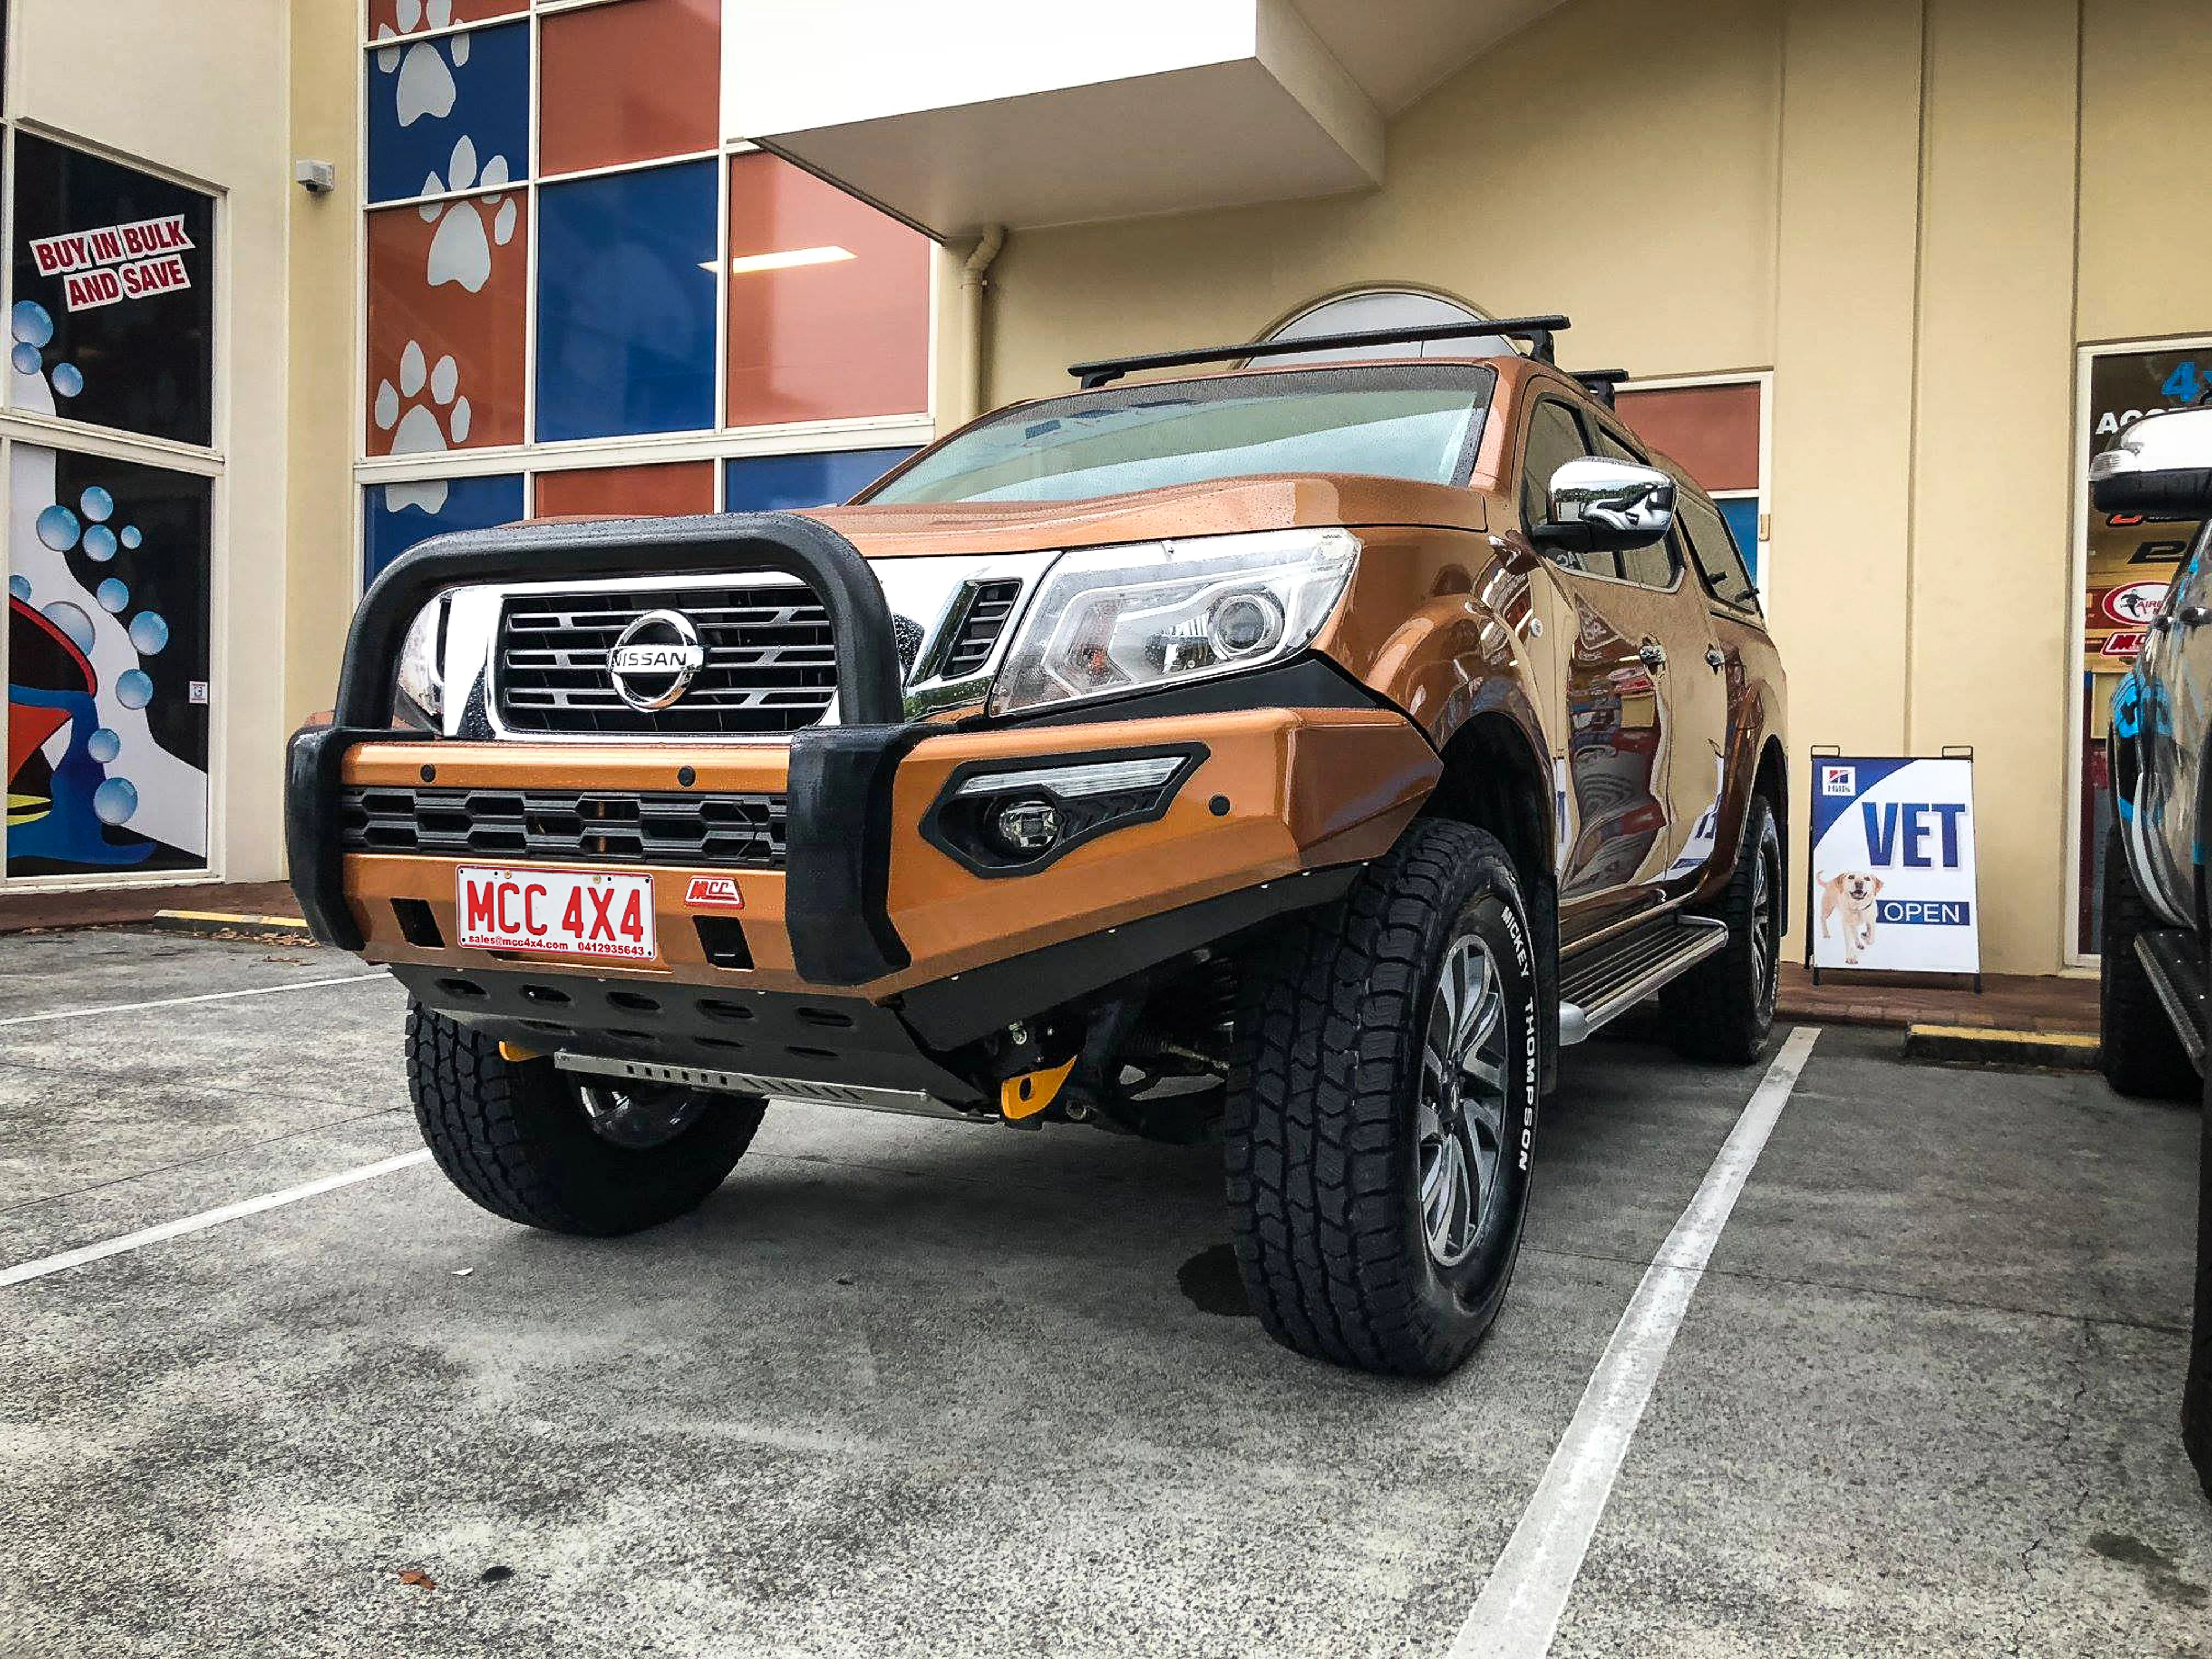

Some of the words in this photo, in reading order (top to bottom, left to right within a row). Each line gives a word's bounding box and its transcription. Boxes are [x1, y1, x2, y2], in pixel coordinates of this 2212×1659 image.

[36, 237, 87, 270] BUY
[91, 231, 121, 260] IN
[122, 220, 187, 253] BULK
[67, 273, 119, 305] AND
[122, 260, 185, 294] SAVE
[613, 652, 686, 666] NISSAN
[1862, 802, 1965, 867] VET
[467, 881, 547, 936] MCC
[562, 886, 643, 942] 4X4
[1884, 902, 1960, 923] OPEN
[469, 935, 568, 950] sales@mcc4x4.com
[578, 942, 644, 956] 0412935643
[1501, 906, 1530, 977] MICKEY
[1519, 996, 1535, 1171] THOMPSON
